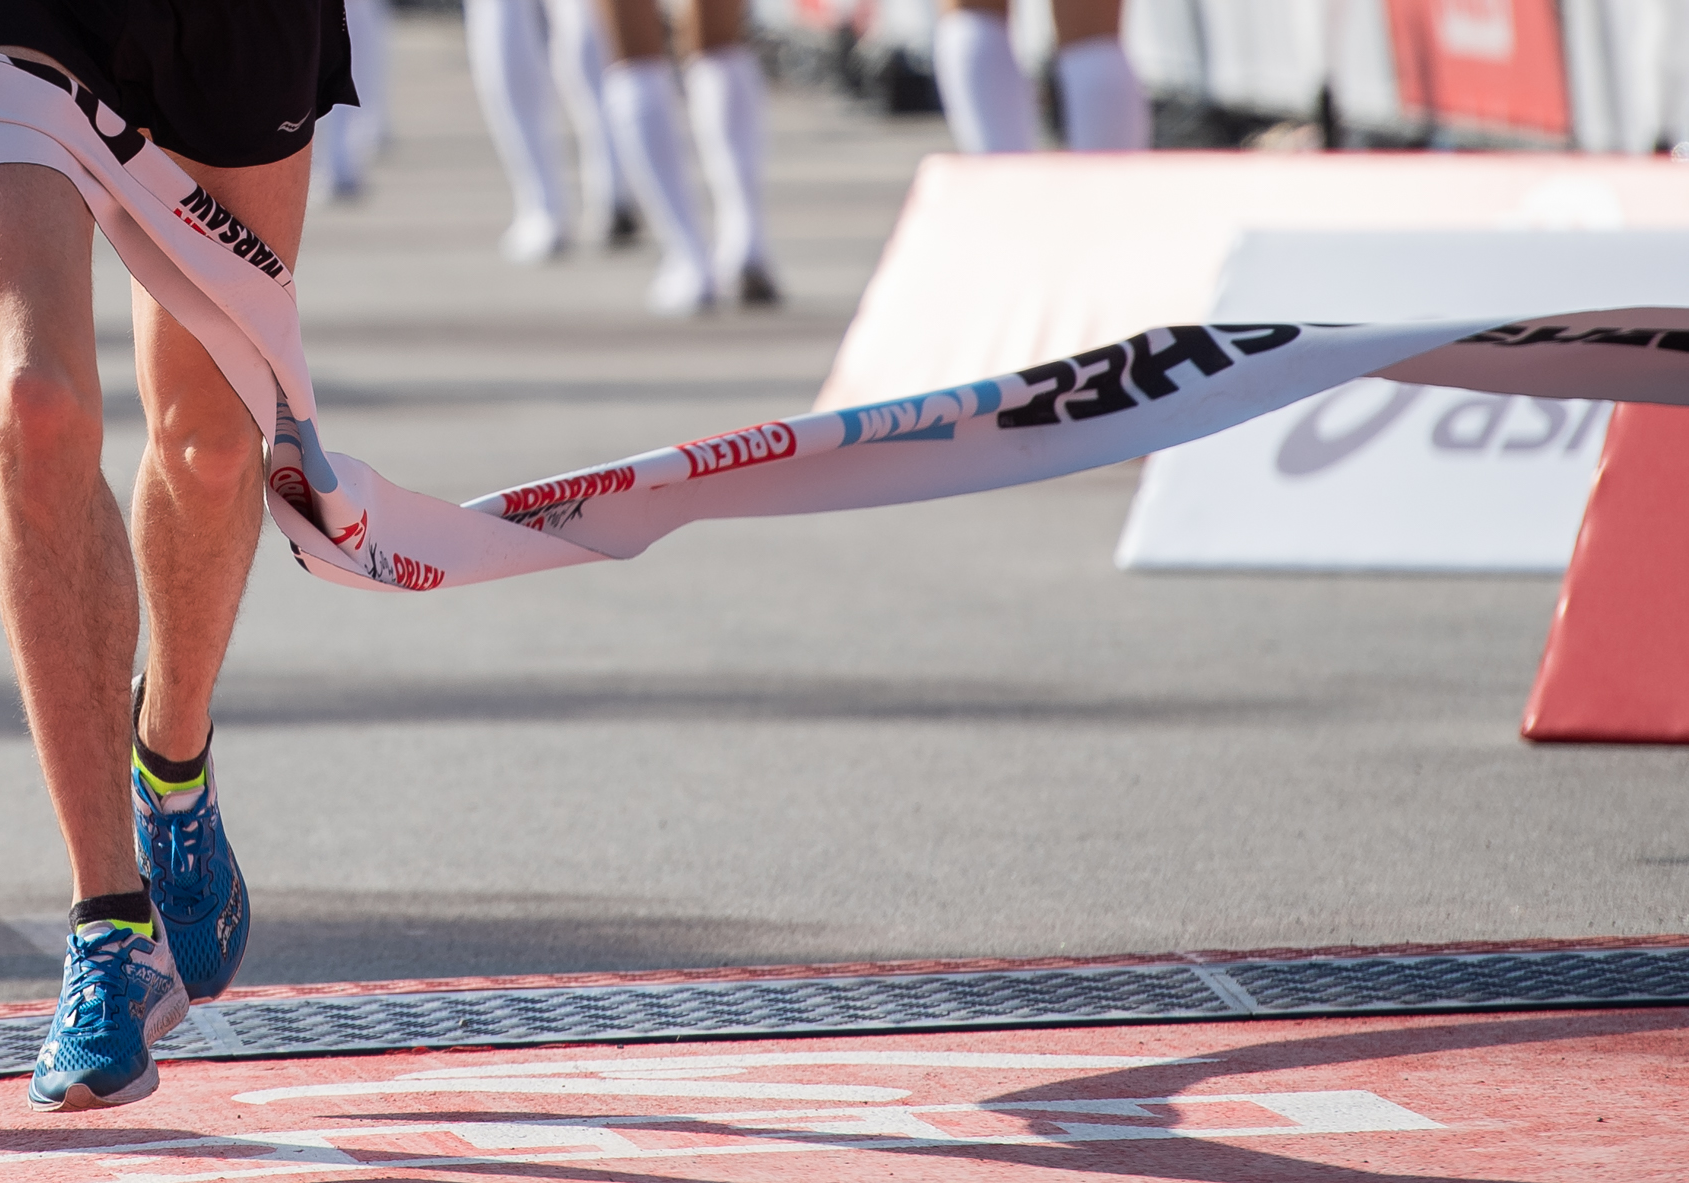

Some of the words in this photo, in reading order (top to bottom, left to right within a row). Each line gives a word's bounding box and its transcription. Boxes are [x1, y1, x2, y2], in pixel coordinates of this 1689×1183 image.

[180, 183, 285, 281] WARSAW
[685, 423, 790, 476] ORLEN
[502, 465, 636, 516] MARATHON
[393, 552, 445, 591] ORLEN
